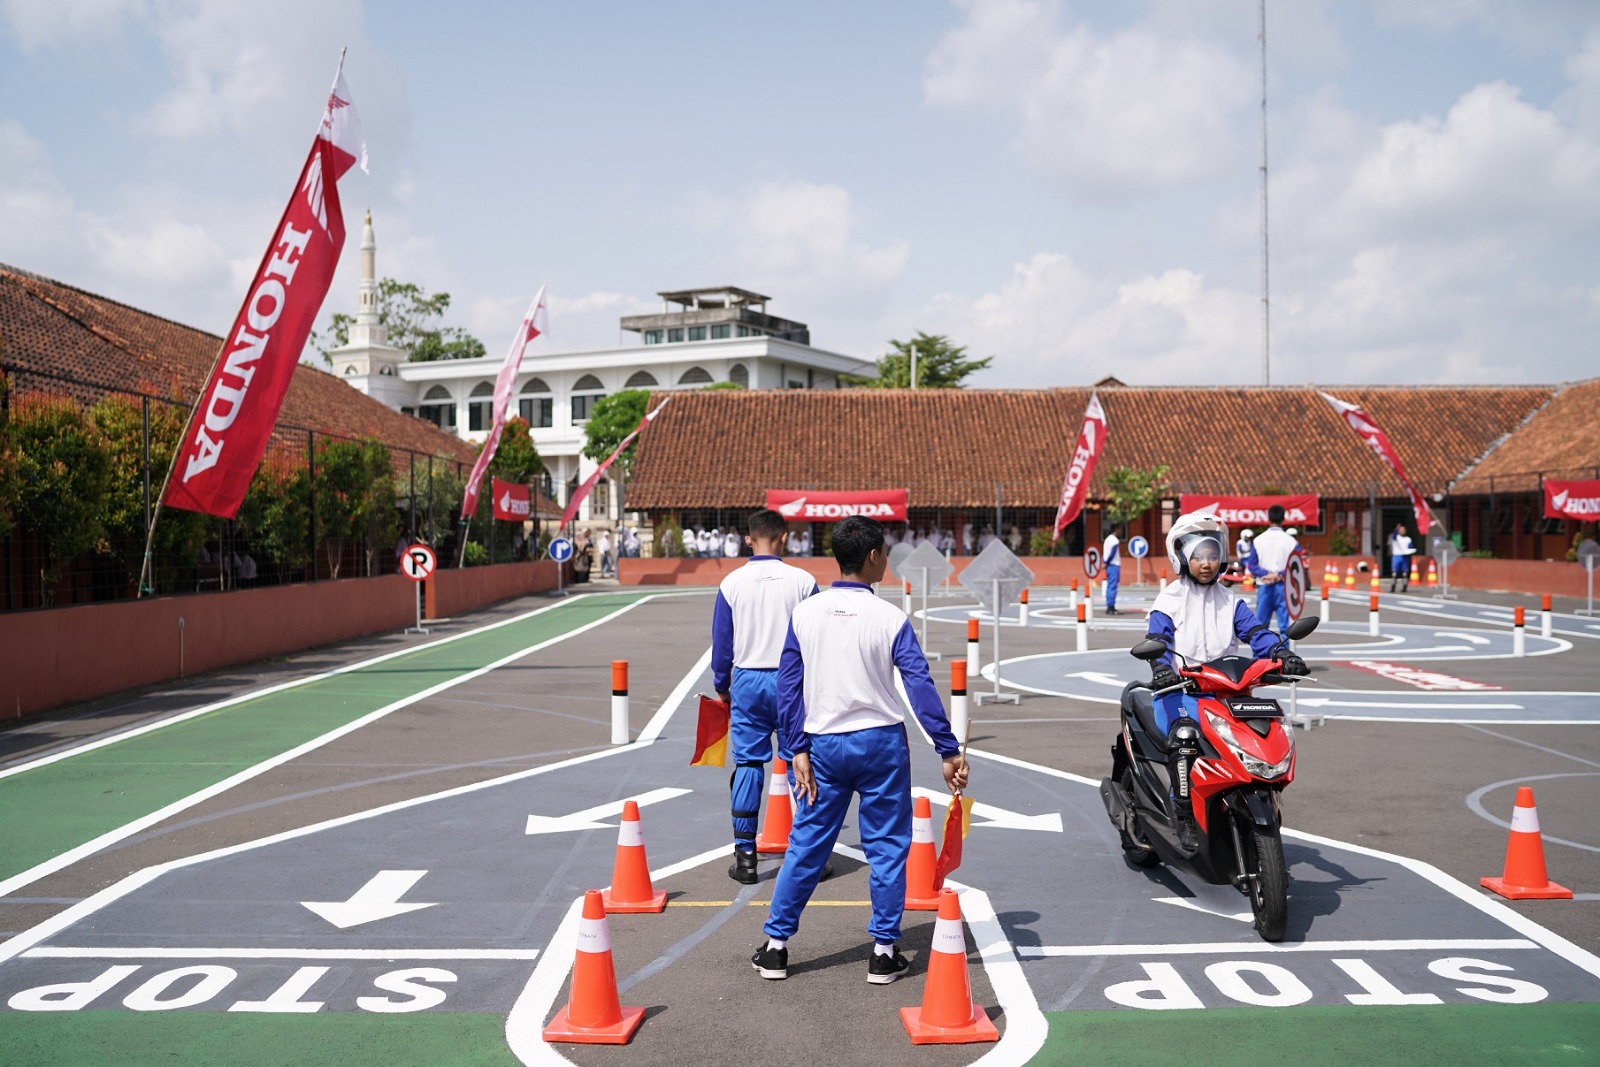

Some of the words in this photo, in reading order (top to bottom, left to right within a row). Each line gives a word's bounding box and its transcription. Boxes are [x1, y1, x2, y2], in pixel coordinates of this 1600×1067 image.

[182, 220, 313, 483] HONDA
[804, 503, 895, 517] HONDA
[412, 552, 428, 575] P
[1290, 560, 1300, 607] S
[1214, 762, 1233, 779] HONDA
[8, 965, 458, 1012] STOP
[1103, 957, 1549, 1010] STOP
